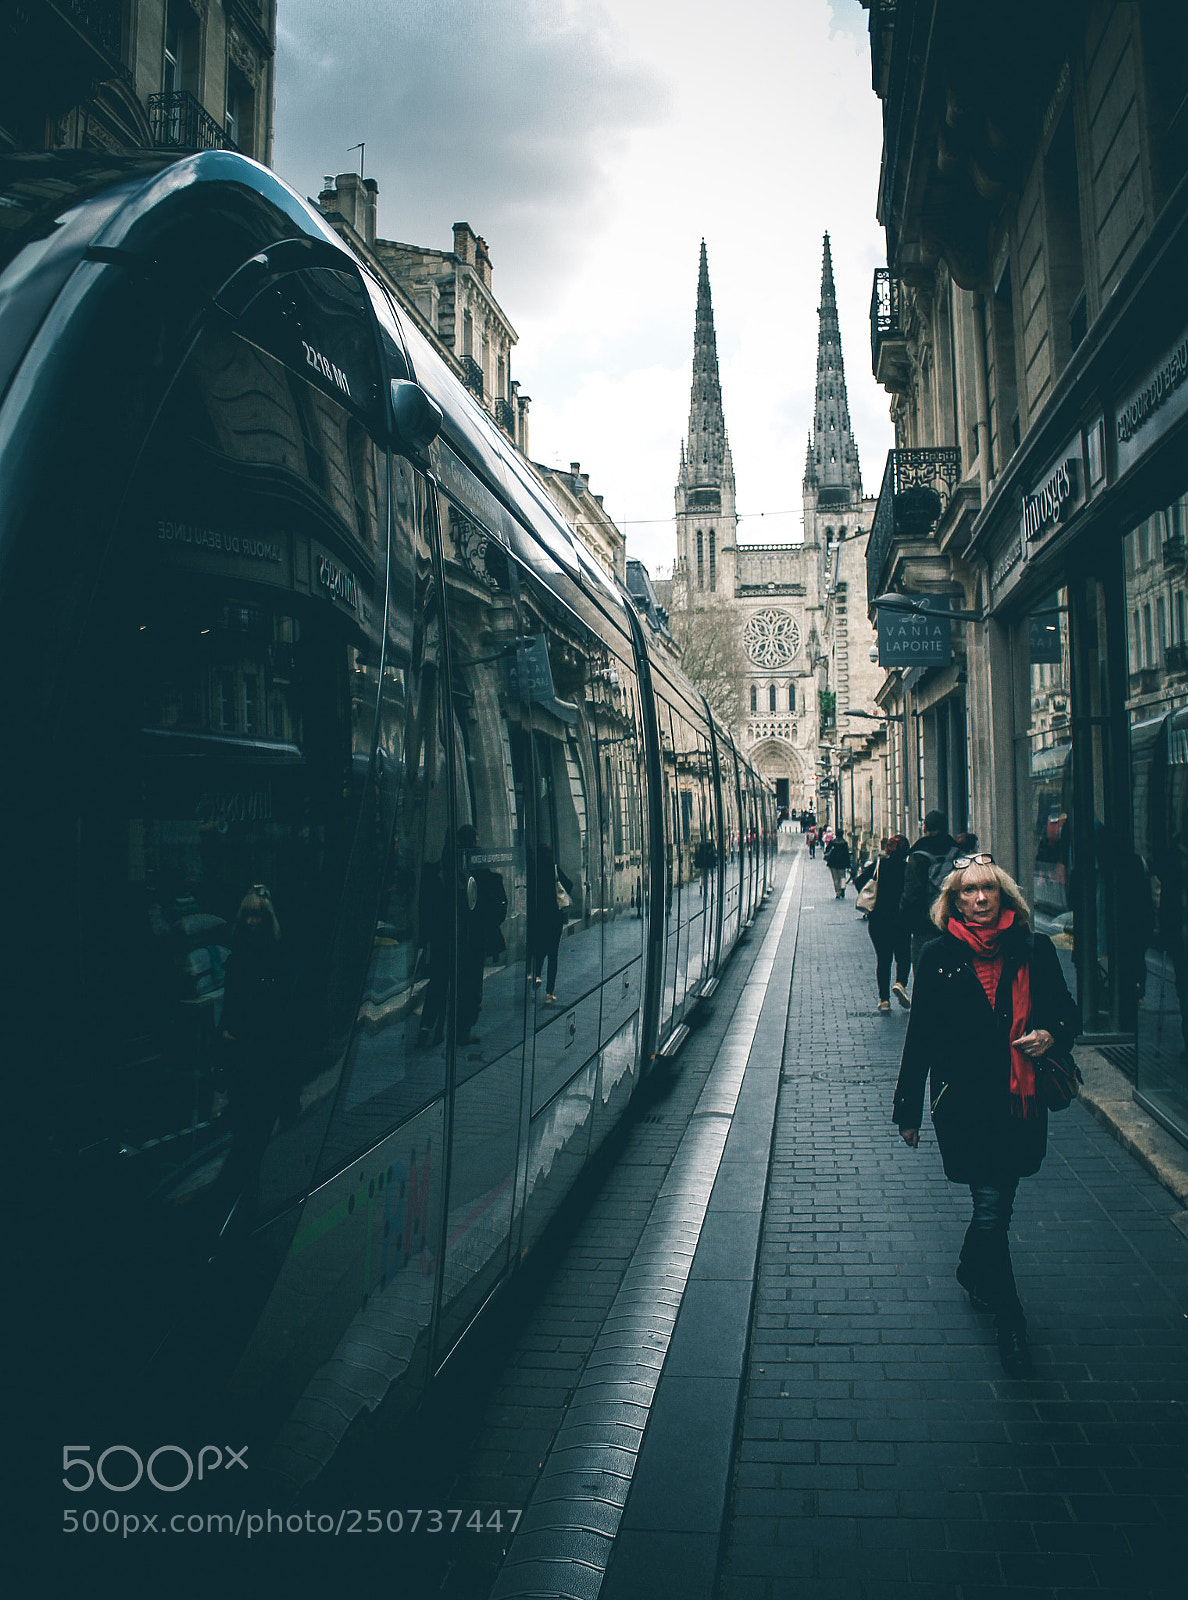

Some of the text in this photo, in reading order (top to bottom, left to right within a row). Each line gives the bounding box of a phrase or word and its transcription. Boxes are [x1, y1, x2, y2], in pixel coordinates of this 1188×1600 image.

[301, 340, 351, 398] 2218 M1
[1117, 392, 1149, 442] L'AMOUR
[1022, 458, 1070, 543] linvosges
[885, 625, 943, 637] VANIA
[886, 640, 943, 652] LAPORTE
